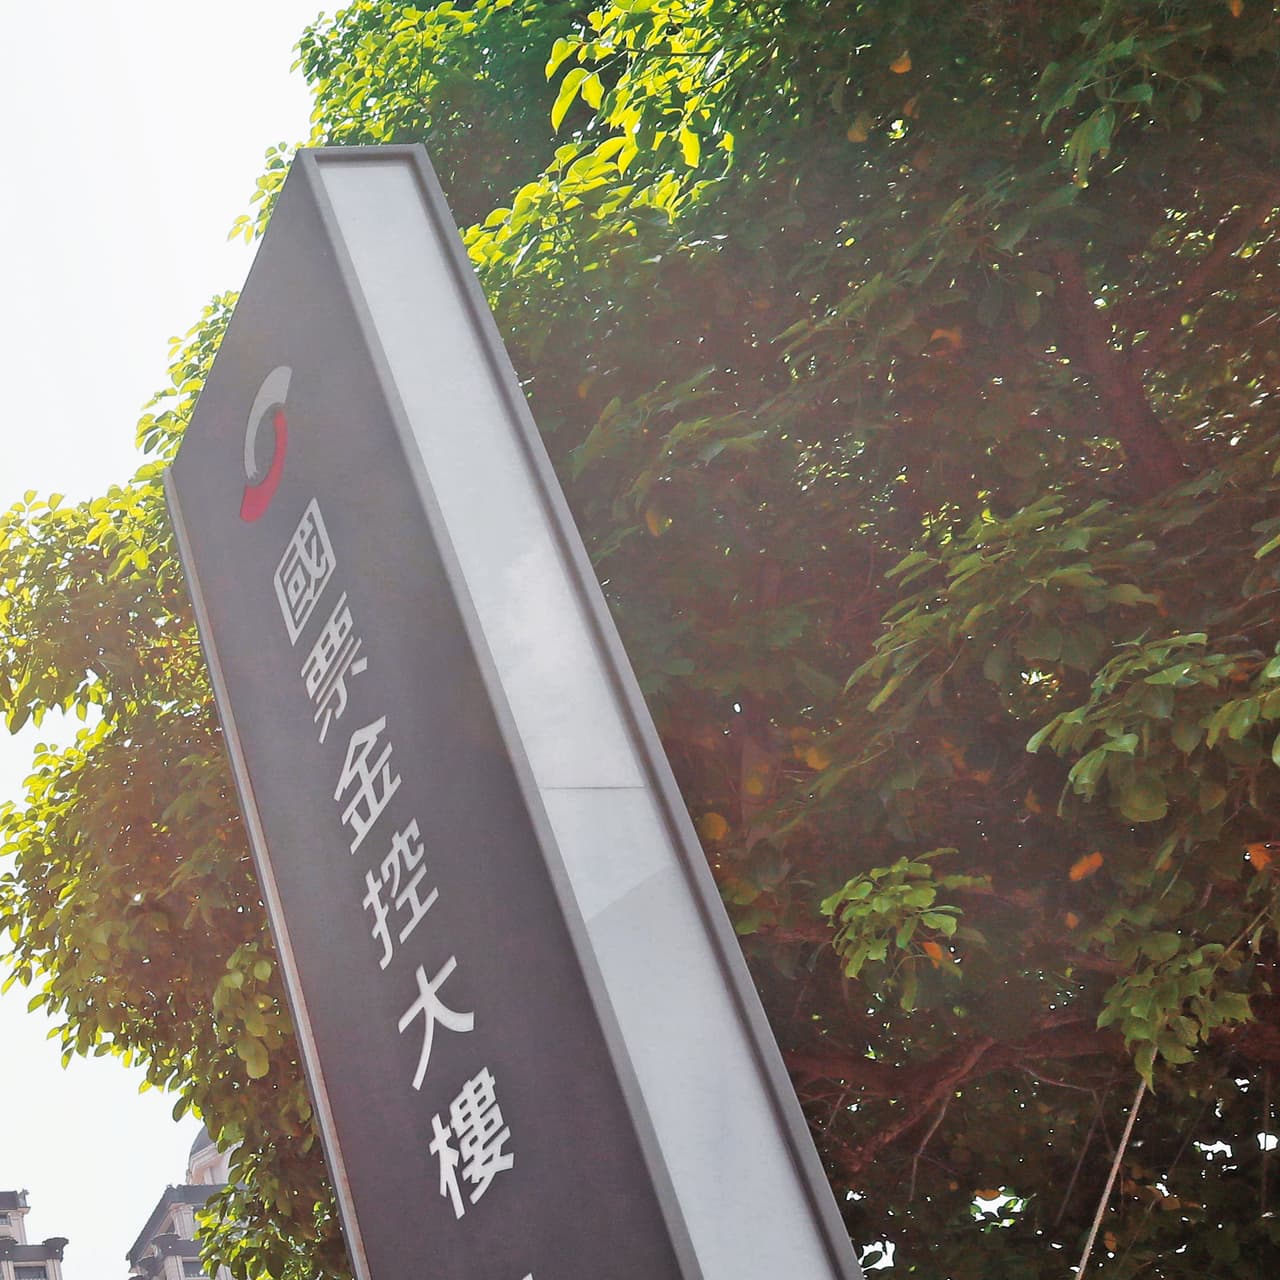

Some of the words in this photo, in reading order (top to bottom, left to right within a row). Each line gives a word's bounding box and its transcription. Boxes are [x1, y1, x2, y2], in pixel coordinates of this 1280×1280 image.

[274, 497, 515, 1219] 國票金控大樓
